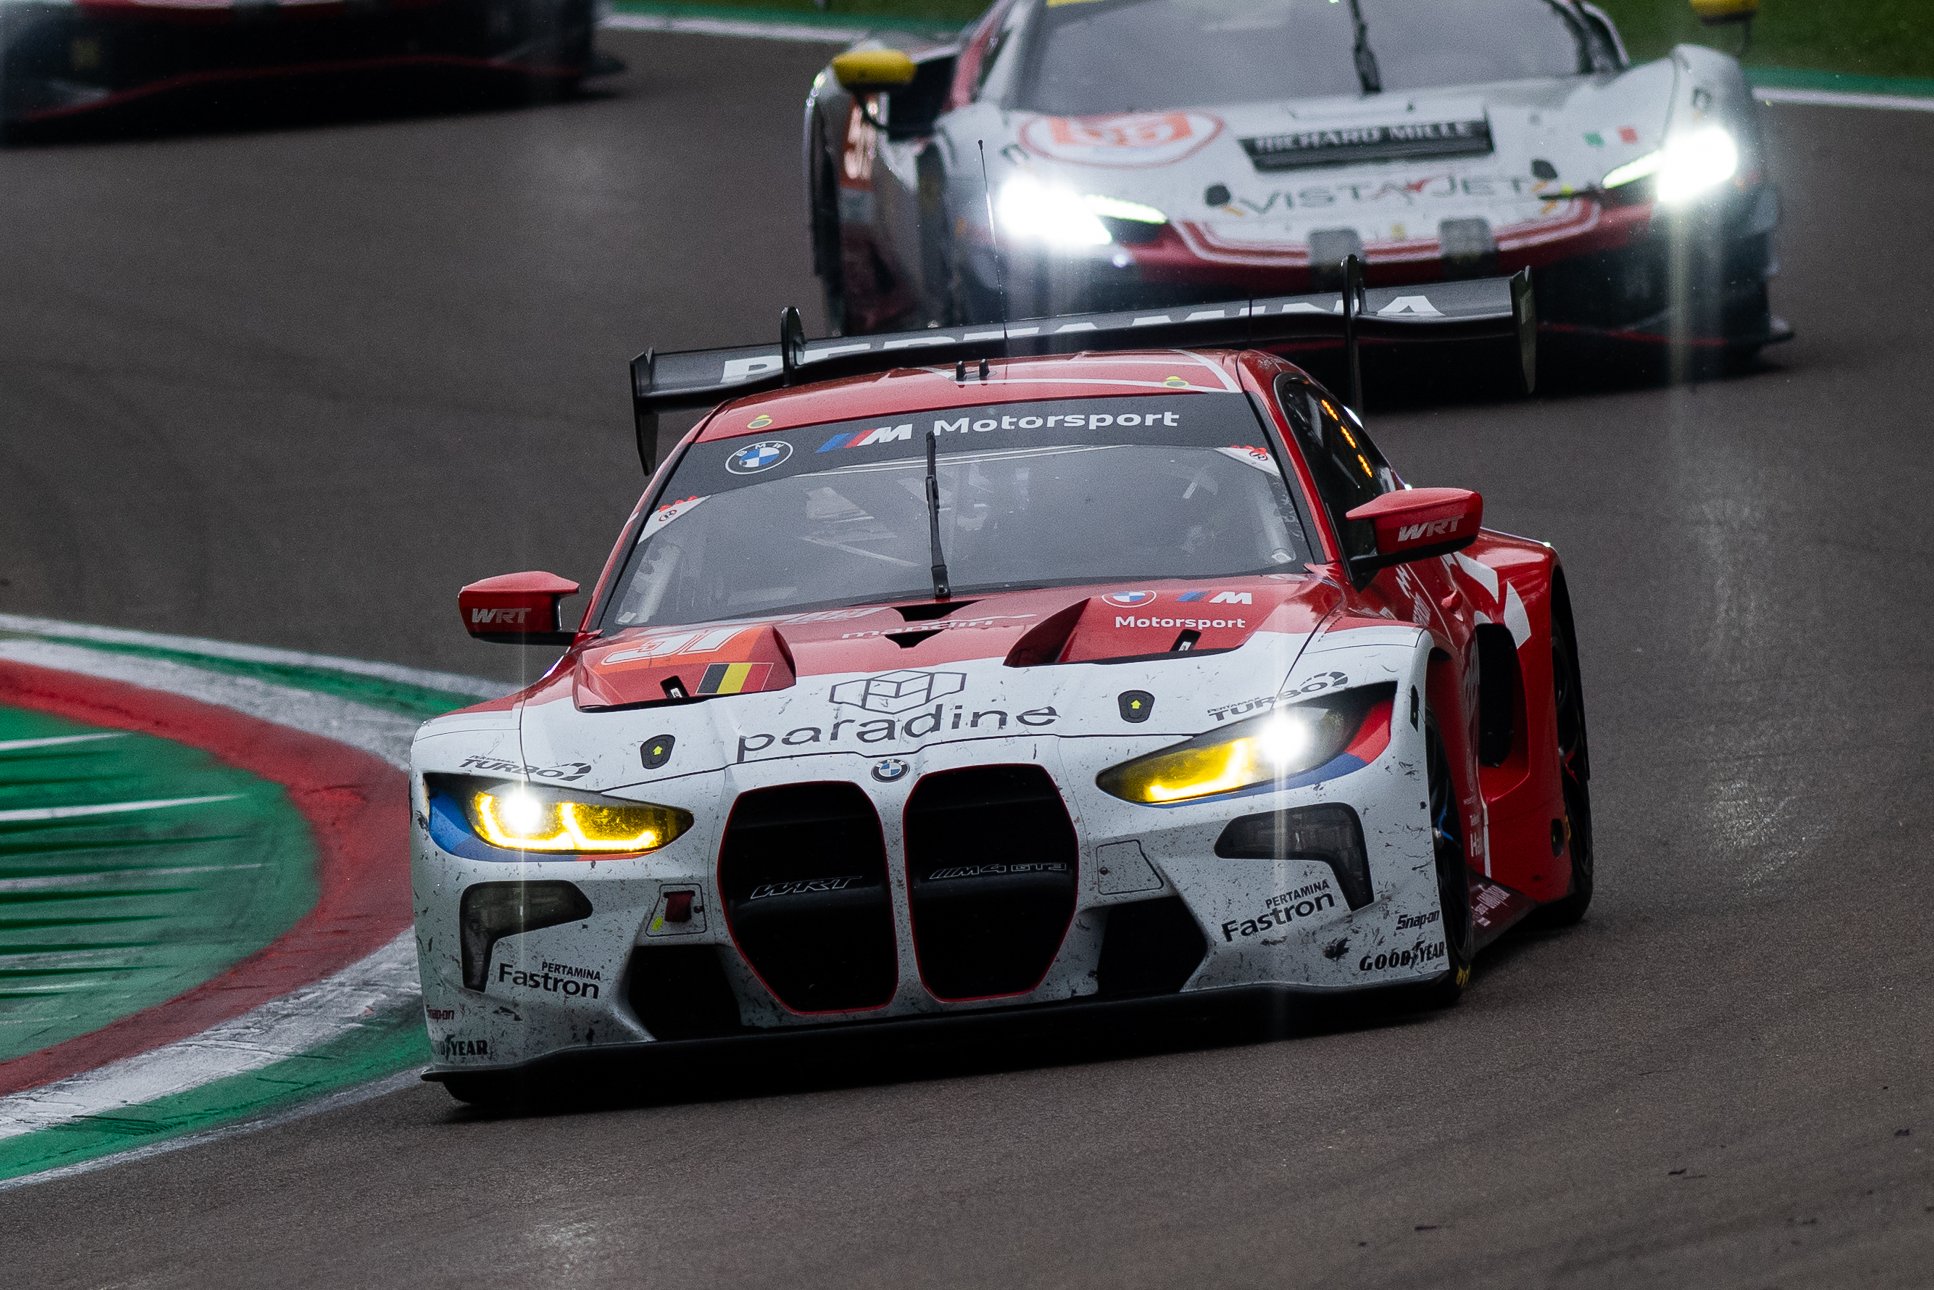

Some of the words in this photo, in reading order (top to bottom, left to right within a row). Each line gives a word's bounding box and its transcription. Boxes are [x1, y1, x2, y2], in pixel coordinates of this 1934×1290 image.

[933, 411, 1180, 437] Motorsport
[1397, 514, 1466, 543] WRT
[471, 607, 533, 624] WRT
[1115, 615, 1246, 630] Motorsport
[1208, 681, 1329, 722] TURBO
[737, 703, 1062, 764] paradine
[459, 758, 565, 779] TURBO
[1010, 862, 1068, 873] GT3
[750, 875, 863, 900] WRT
[1266, 879, 1331, 909] PERTAMINA
[1221, 892, 1335, 943] Fastron
[1396, 909, 1441, 931] Snap-on
[499, 962, 601, 1000] Fastron
[541, 961, 602, 981] PERTAMINA
